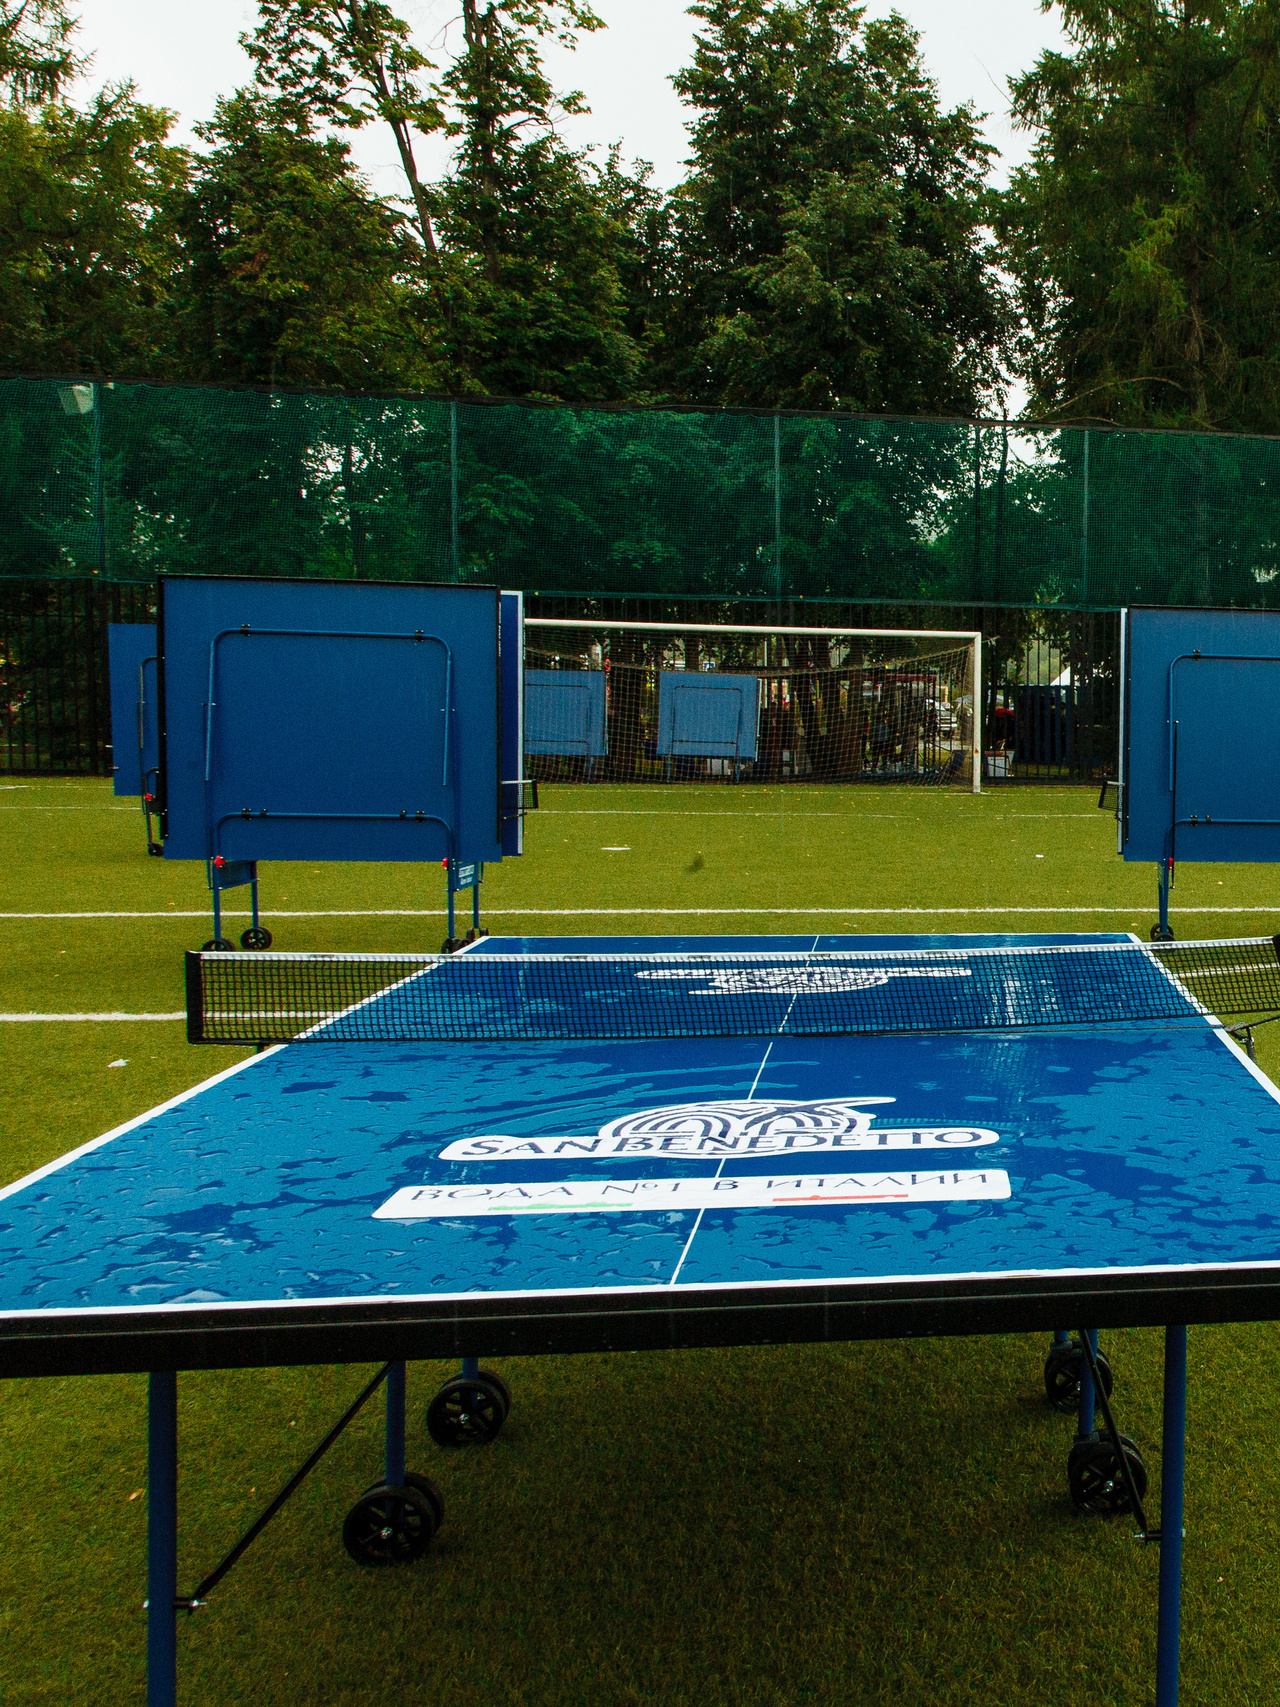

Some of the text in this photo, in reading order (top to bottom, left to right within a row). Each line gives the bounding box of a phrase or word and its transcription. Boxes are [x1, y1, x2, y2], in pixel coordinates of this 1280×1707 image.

[410, 1186, 574, 1201] ВОДА
[712, 1179, 739, 1191] В
[766, 1173, 987, 1189] ИТАЛИИ
